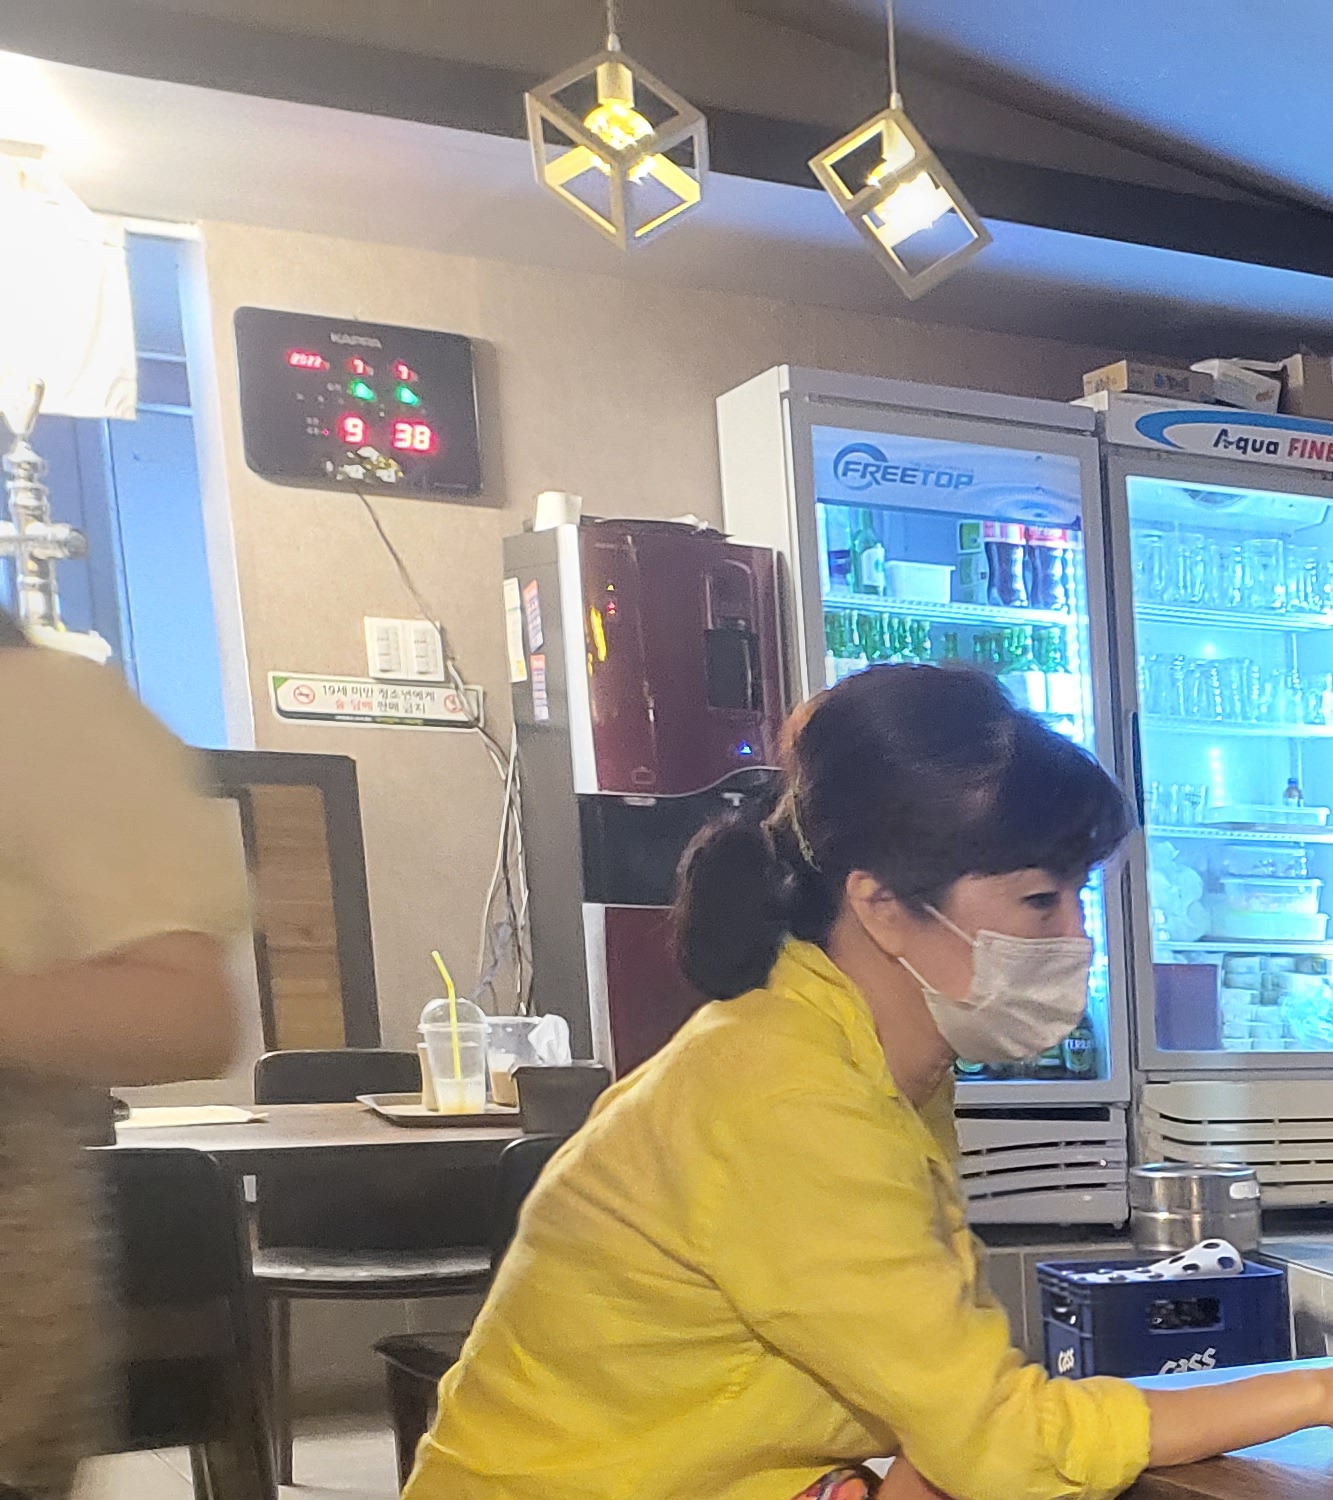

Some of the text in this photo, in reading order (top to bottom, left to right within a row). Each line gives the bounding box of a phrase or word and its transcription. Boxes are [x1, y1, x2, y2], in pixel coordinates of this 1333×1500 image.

[343, 417, 431, 450] 9 38
[841, 460, 975, 489] FREETOP
